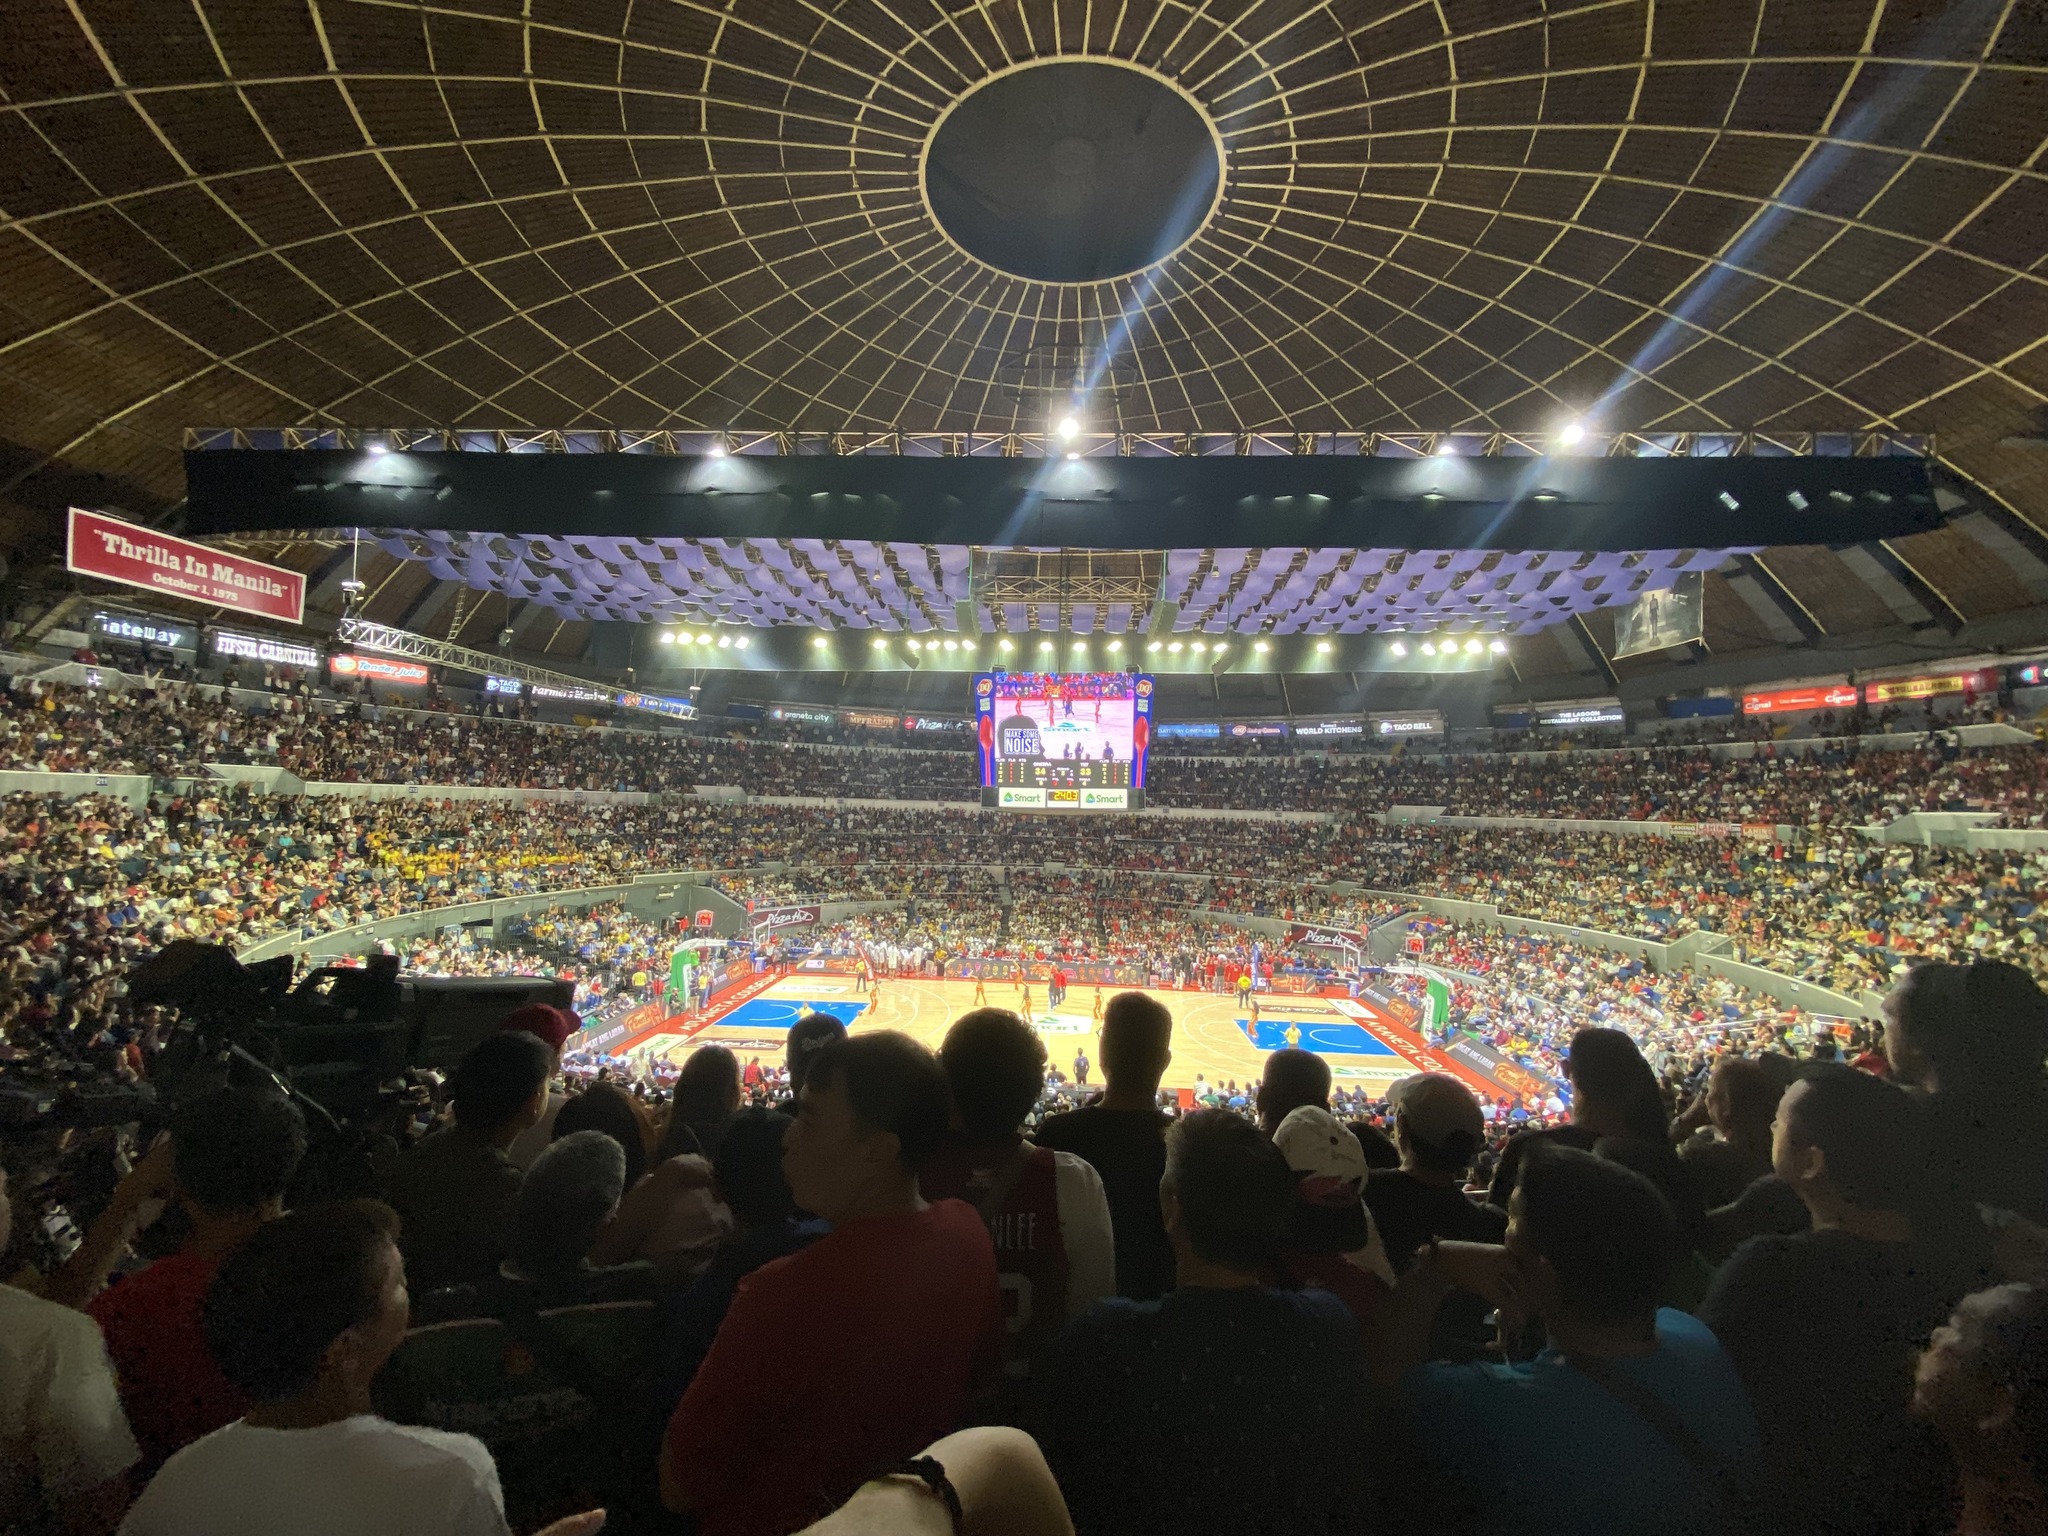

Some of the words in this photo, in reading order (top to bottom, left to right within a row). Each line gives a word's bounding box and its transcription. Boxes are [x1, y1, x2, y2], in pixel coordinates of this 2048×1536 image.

[185, 556, 208, 579] In
[152, 573, 200, 592] October
[213, 587, 239, 602] 1975
[217, 637, 258, 658] FIESTA
[259, 643, 318, 667] CARNIVAL
[358, 661, 398, 674] Tender
[396, 667, 425, 678] Juicy
[500, 686, 520, 694] BELL
[1745, 698, 1772, 710] Cignal
[1824, 690, 1855, 704] Cignal
[785, 711, 812, 720] araneta
[814, 714, 829, 723] city
[916, 717, 943, 730] Pizza
[1005, 729, 1021, 738] MAKE
[1023, 729, 1039, 738] SOME
[1324, 726, 1362, 734] KITCHENS
[1006, 739, 1040, 753] NOISE
[1035, 767, 1046, 775] 34
[1014, 794, 1041, 802] Smart
[1096, 795, 1123, 803] Smart
[767, 909, 791, 924] Pizza
[791, 909, 812, 922] Hut
[1305, 928, 1333, 944] Pizza
[1332, 932, 1354, 948] Hut
[679, 1000, 739, 1031] ARANETA
[1363, 1020, 1418, 1055] ARANETA
